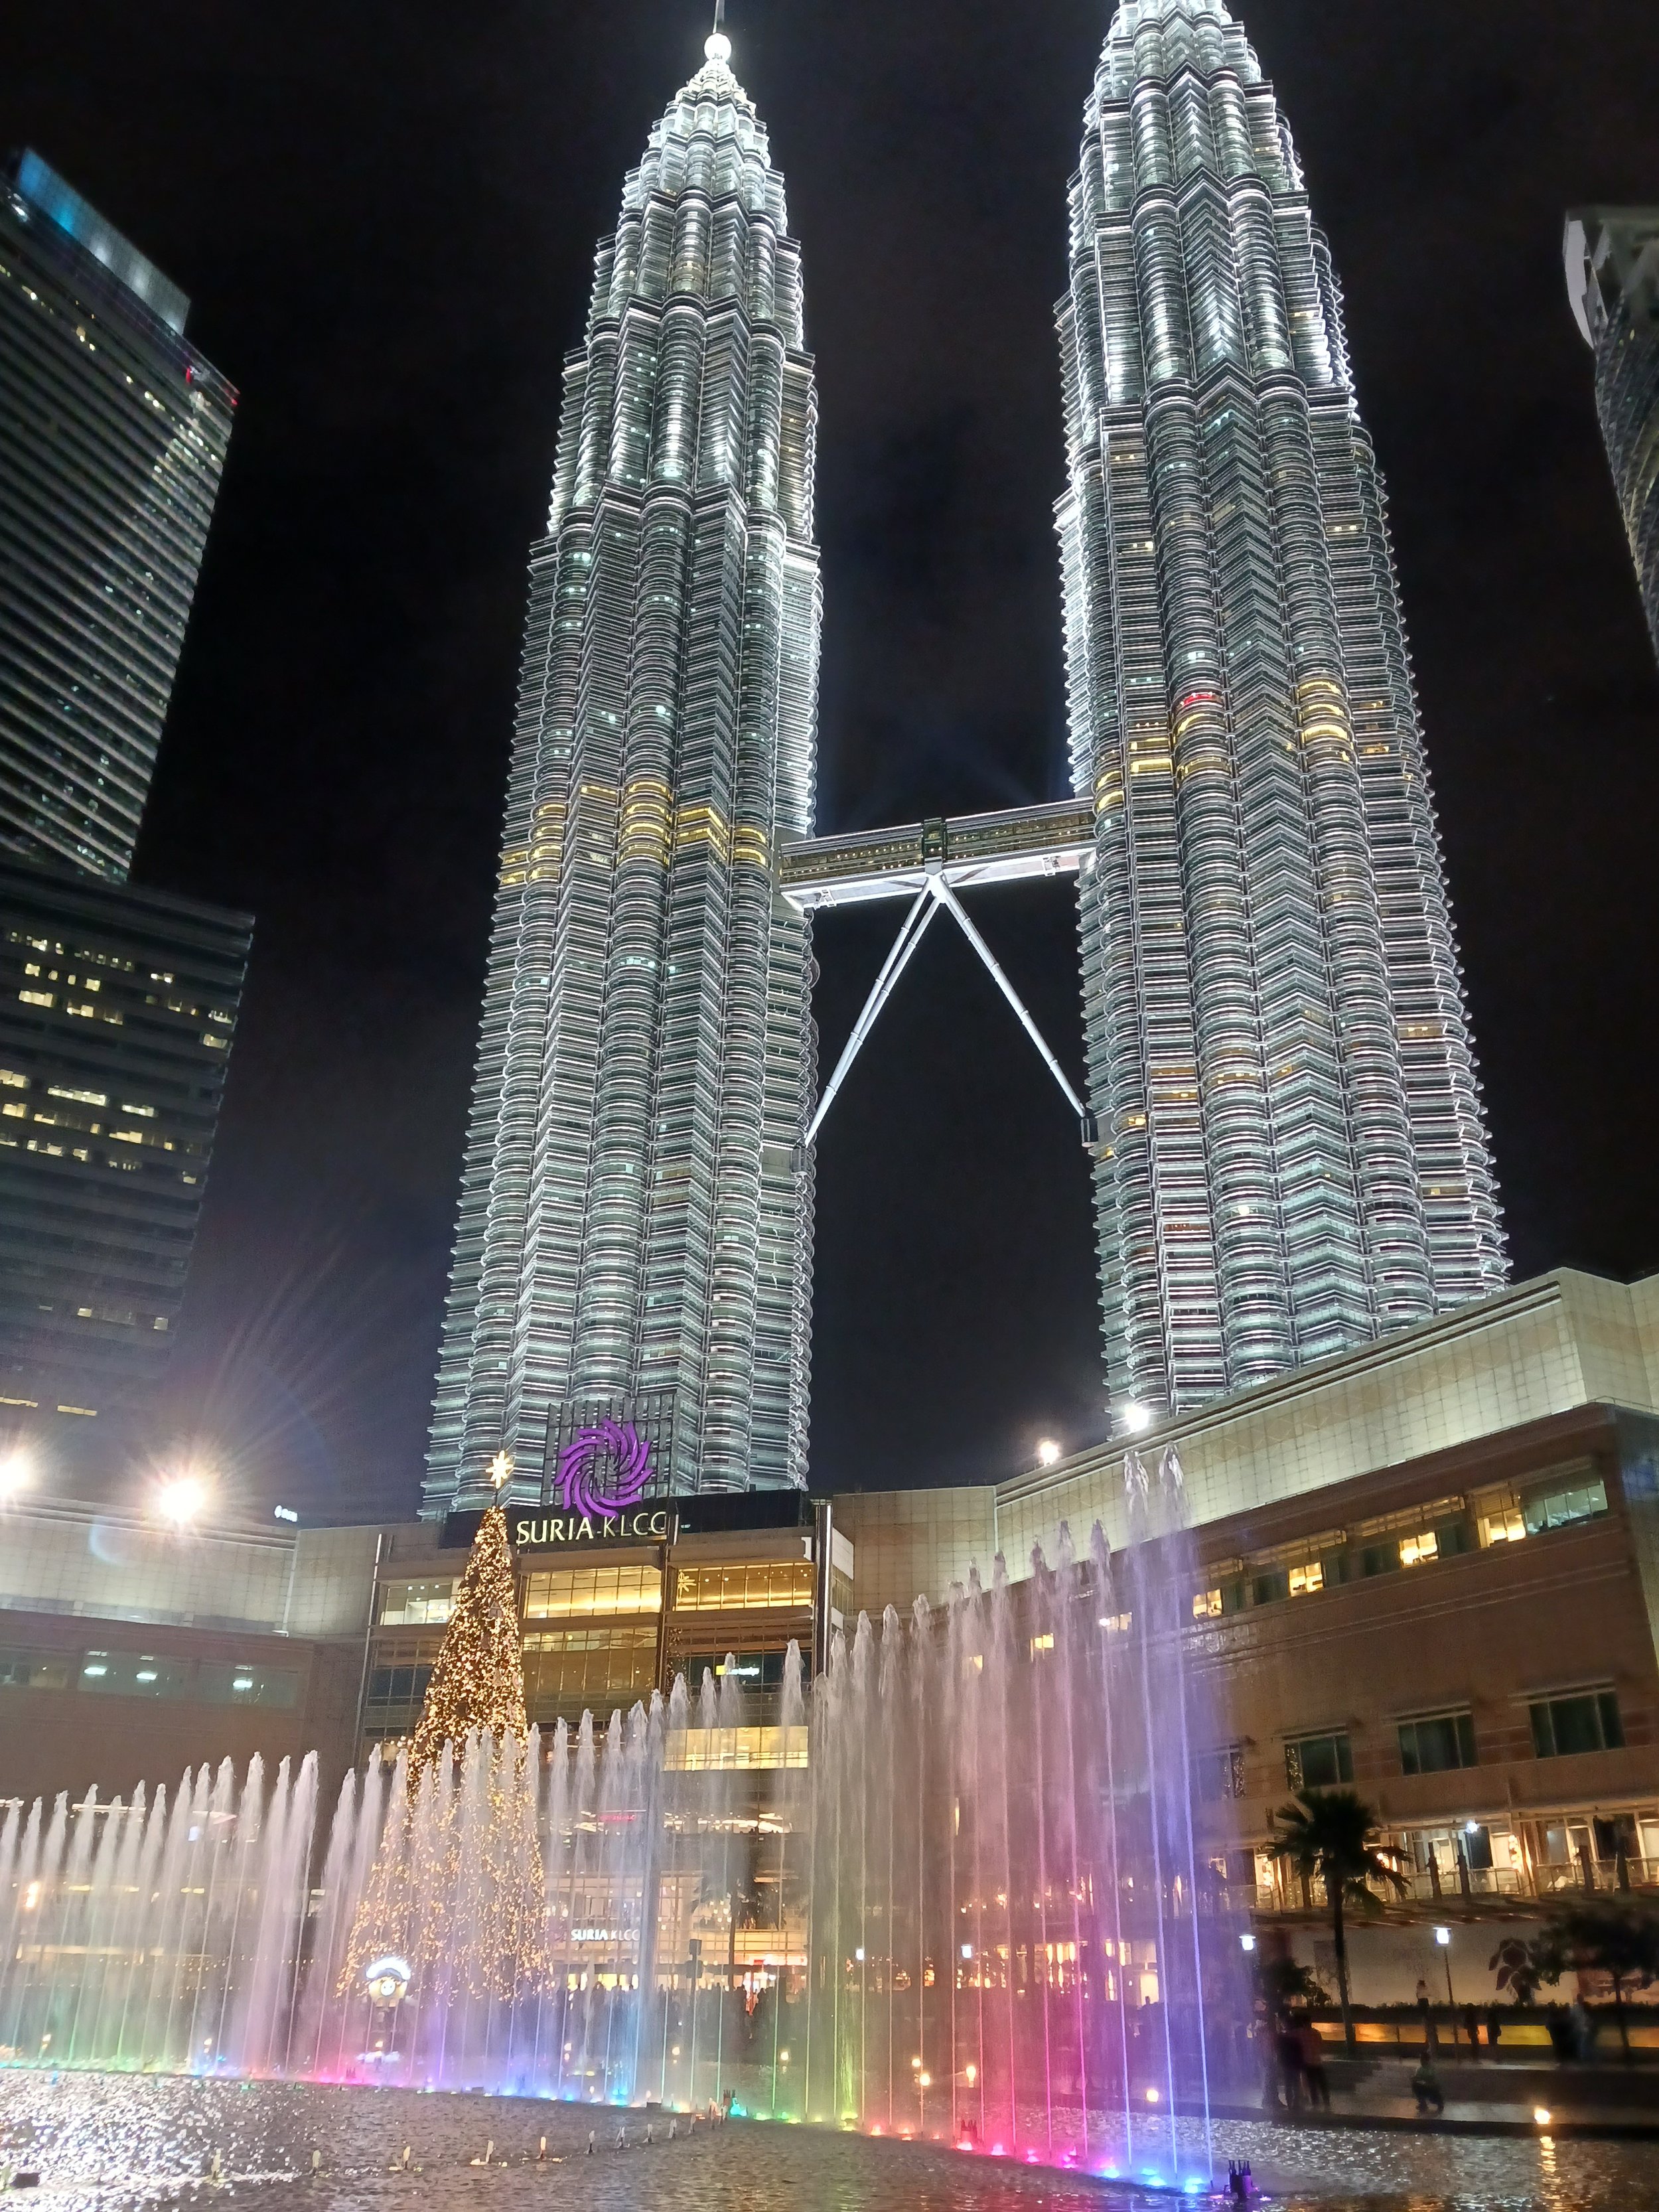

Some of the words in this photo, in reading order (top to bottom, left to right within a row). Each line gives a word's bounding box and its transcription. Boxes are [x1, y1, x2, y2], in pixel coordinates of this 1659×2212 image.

[516, 1516, 594, 1544] SURIA
[603, 1511, 666, 1538] KLCC
[571, 1929, 609, 1941] SURIA
[611, 1929, 640, 1941] KLCC
